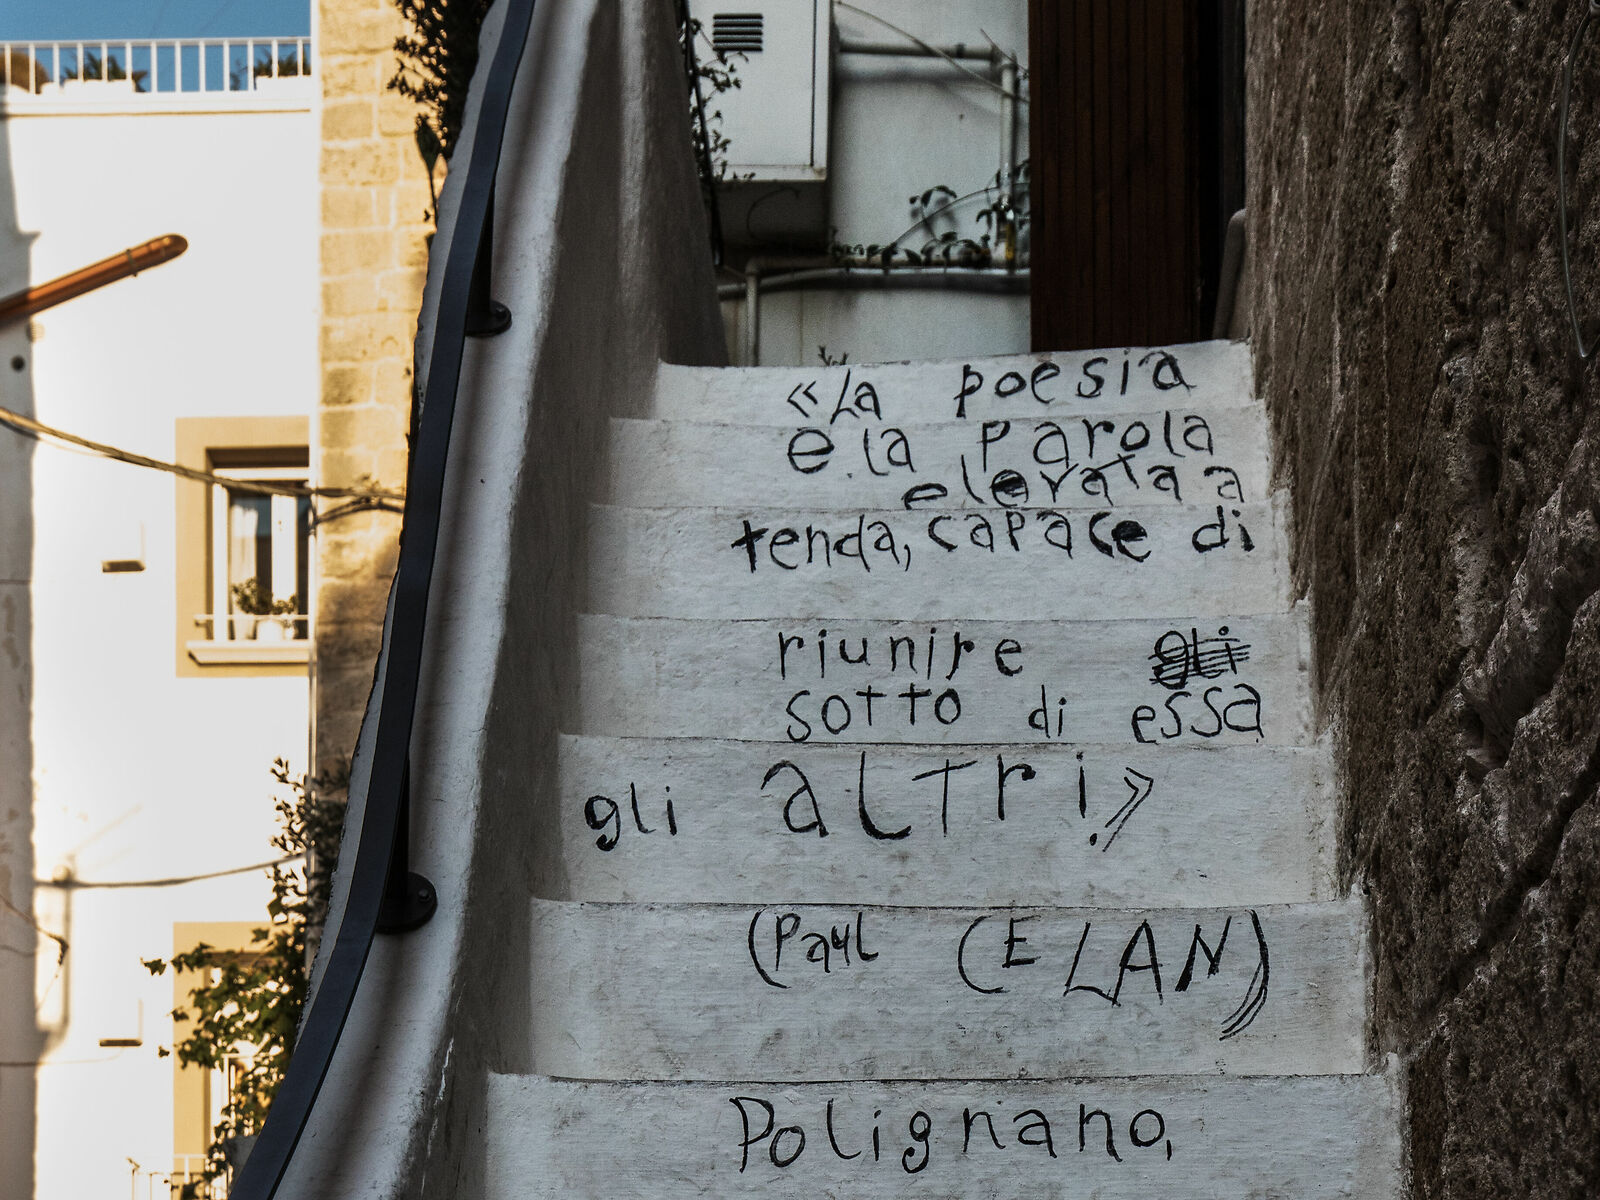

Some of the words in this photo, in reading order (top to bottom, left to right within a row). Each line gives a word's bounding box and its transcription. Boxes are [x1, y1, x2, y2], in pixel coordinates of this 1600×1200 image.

[953, 349, 1196, 418] poesia
[1191, 505, 1255, 559] di
[778, 627, 1024, 681] riunire
[785, 684, 962, 743] sotto
[1027, 684, 1066, 738] di
[1131, 683, 1265, 744] essa
[584, 780, 677, 851] gli
[730, 1096, 1172, 1174] Polignano,
